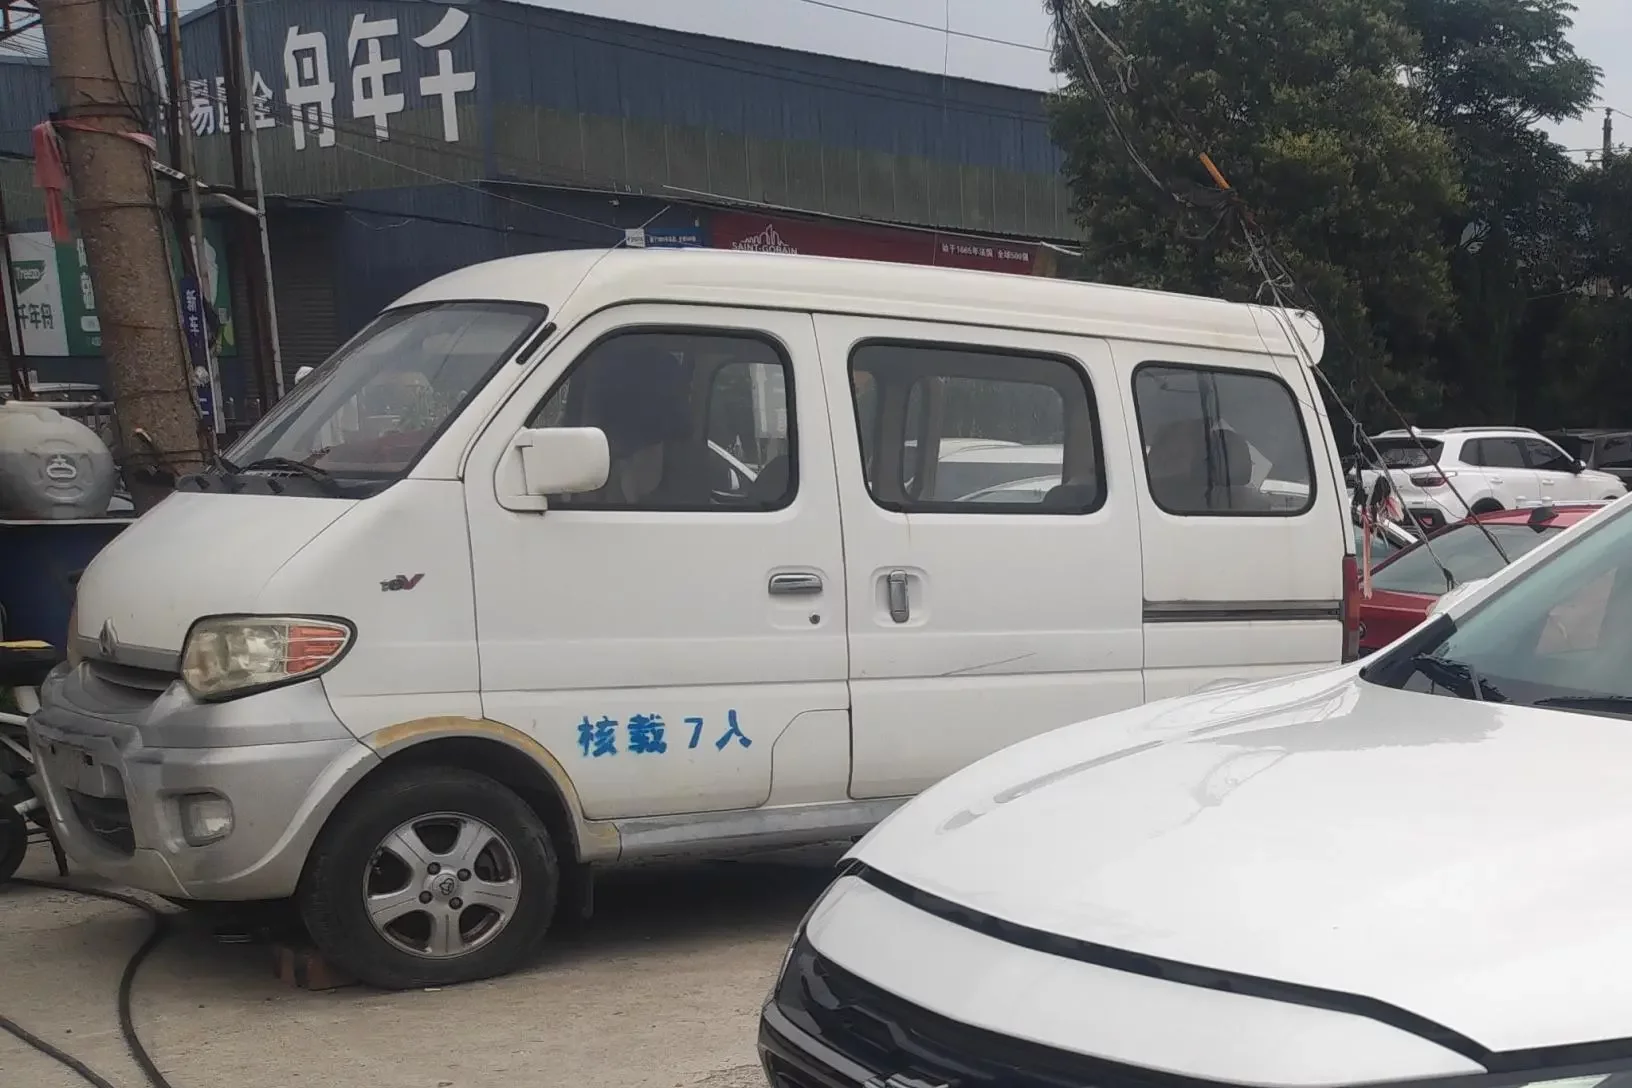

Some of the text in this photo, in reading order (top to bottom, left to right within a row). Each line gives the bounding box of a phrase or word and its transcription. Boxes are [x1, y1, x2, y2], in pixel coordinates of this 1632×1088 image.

[731, 241, 798, 255] SAINT-GOBAIN
[17, 303, 54, 330] 千年舟
[577, 709, 752, 757] 核载7人
